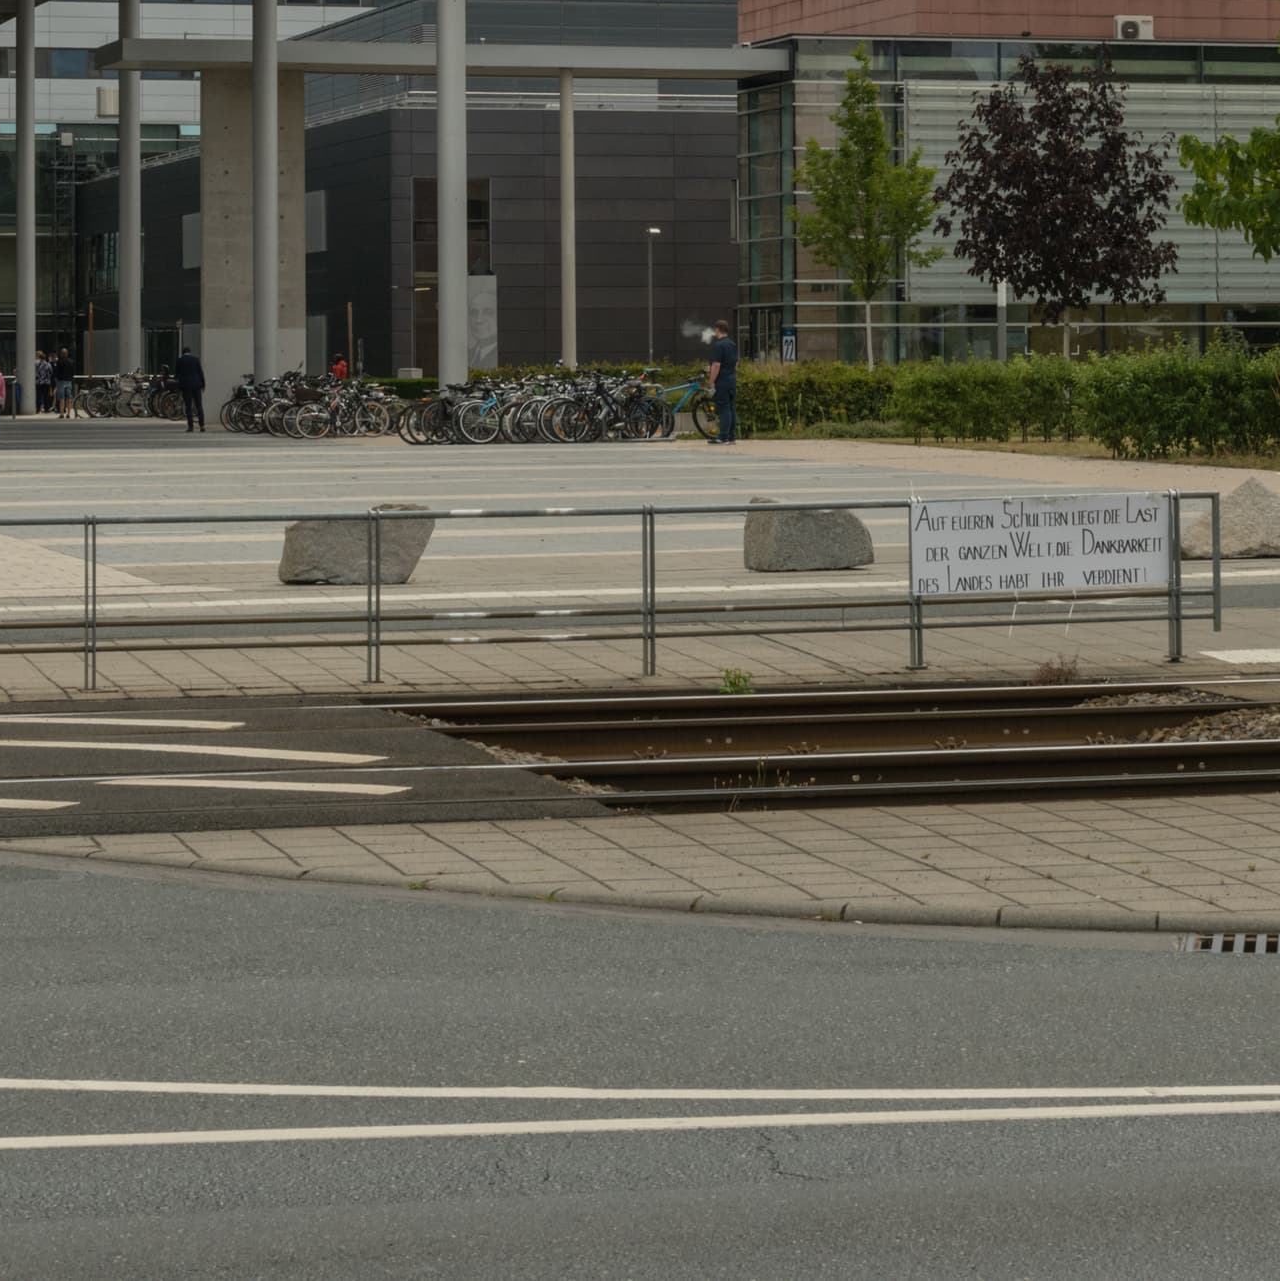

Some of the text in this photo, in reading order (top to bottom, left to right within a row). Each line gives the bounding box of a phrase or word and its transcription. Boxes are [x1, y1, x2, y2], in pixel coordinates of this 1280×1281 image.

[1071, 509, 1102, 526] LIEGT
[1103, 508, 1121, 525] DIE
[1126, 496, 1161, 524] LAST
[925, 546, 950, 562] DER
[958, 544, 1008, 560] GANZEN
[1056, 541, 1073, 557] DIE
[1082, 528, 1164, 556] DANKBARKEIT
[918, 577, 940, 593] DES
[947, 565, 993, 593] LANDES
[999, 573, 1032, 590] HABT
[1041, 572, 1065, 588] IHR
